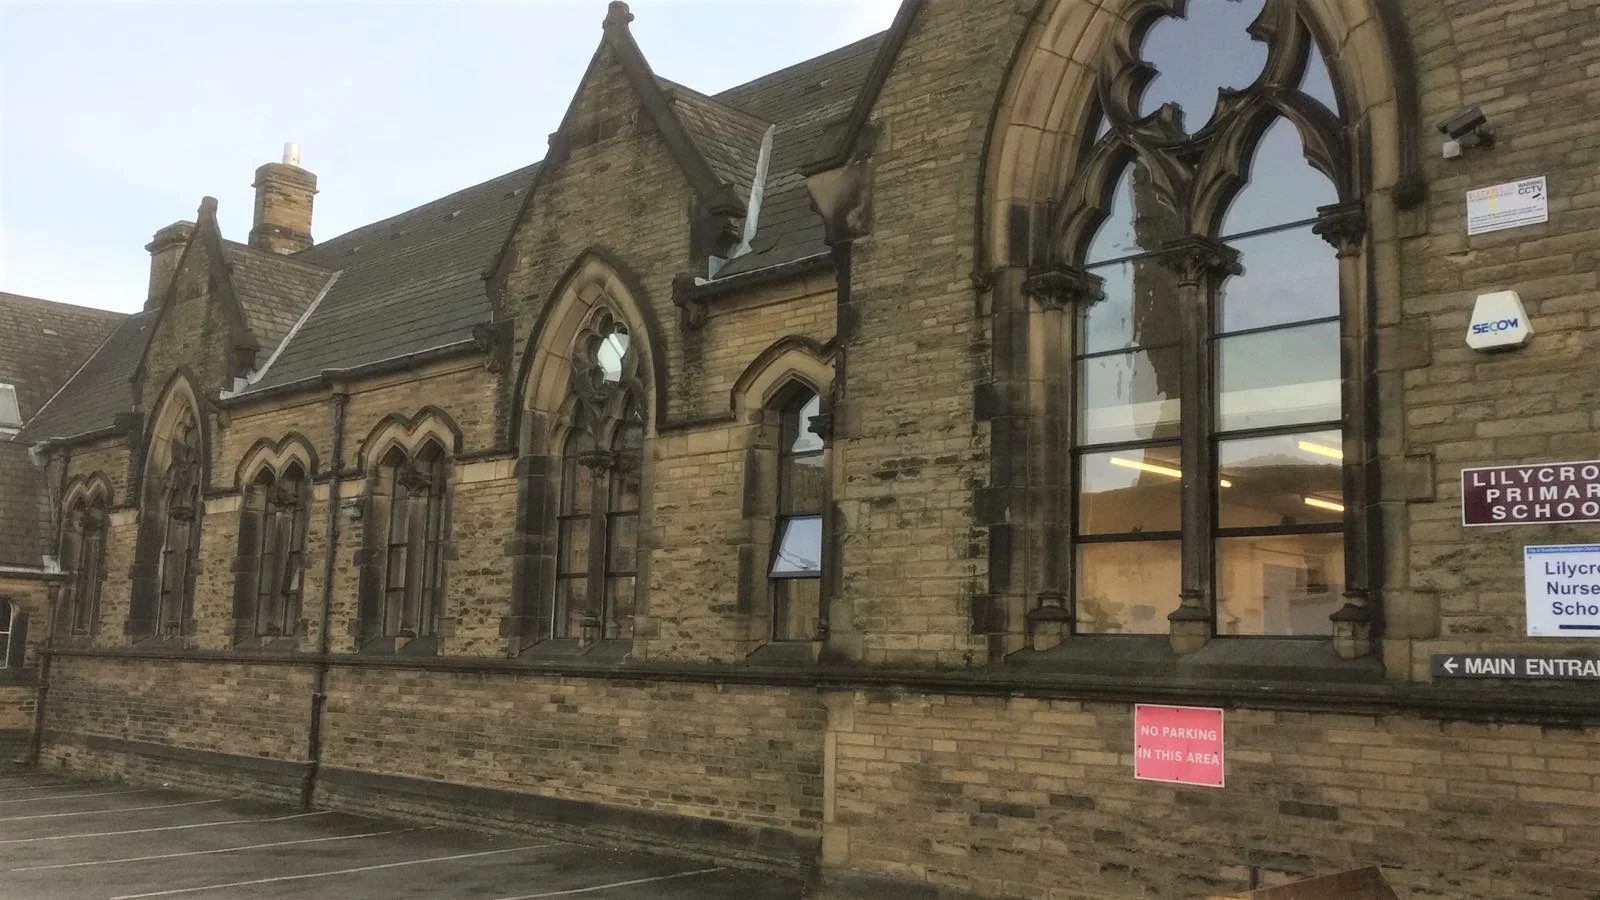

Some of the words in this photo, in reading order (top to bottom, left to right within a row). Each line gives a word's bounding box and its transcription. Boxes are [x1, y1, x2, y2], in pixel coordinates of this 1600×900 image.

[1518, 184, 1543, 195] CCTV
[1472, 317, 1518, 335] SECOM
[1473, 465, 1599, 486] LILYCRO
[1487, 483, 1600, 503] PRIMAR
[1492, 501, 1599, 520] SCHOO
[1552, 601, 1599, 615] Scho
[1465, 657, 1516, 674] MAIN
[1526, 658, 1600, 677] ENTRA
[1141, 725, 1158, 736] NO
[1163, 726, 1217, 741] PARKING
[1138, 748, 1152, 759] IN
[1155, 749, 1182, 762] THIS
[1186, 752, 1220, 766] AREA
